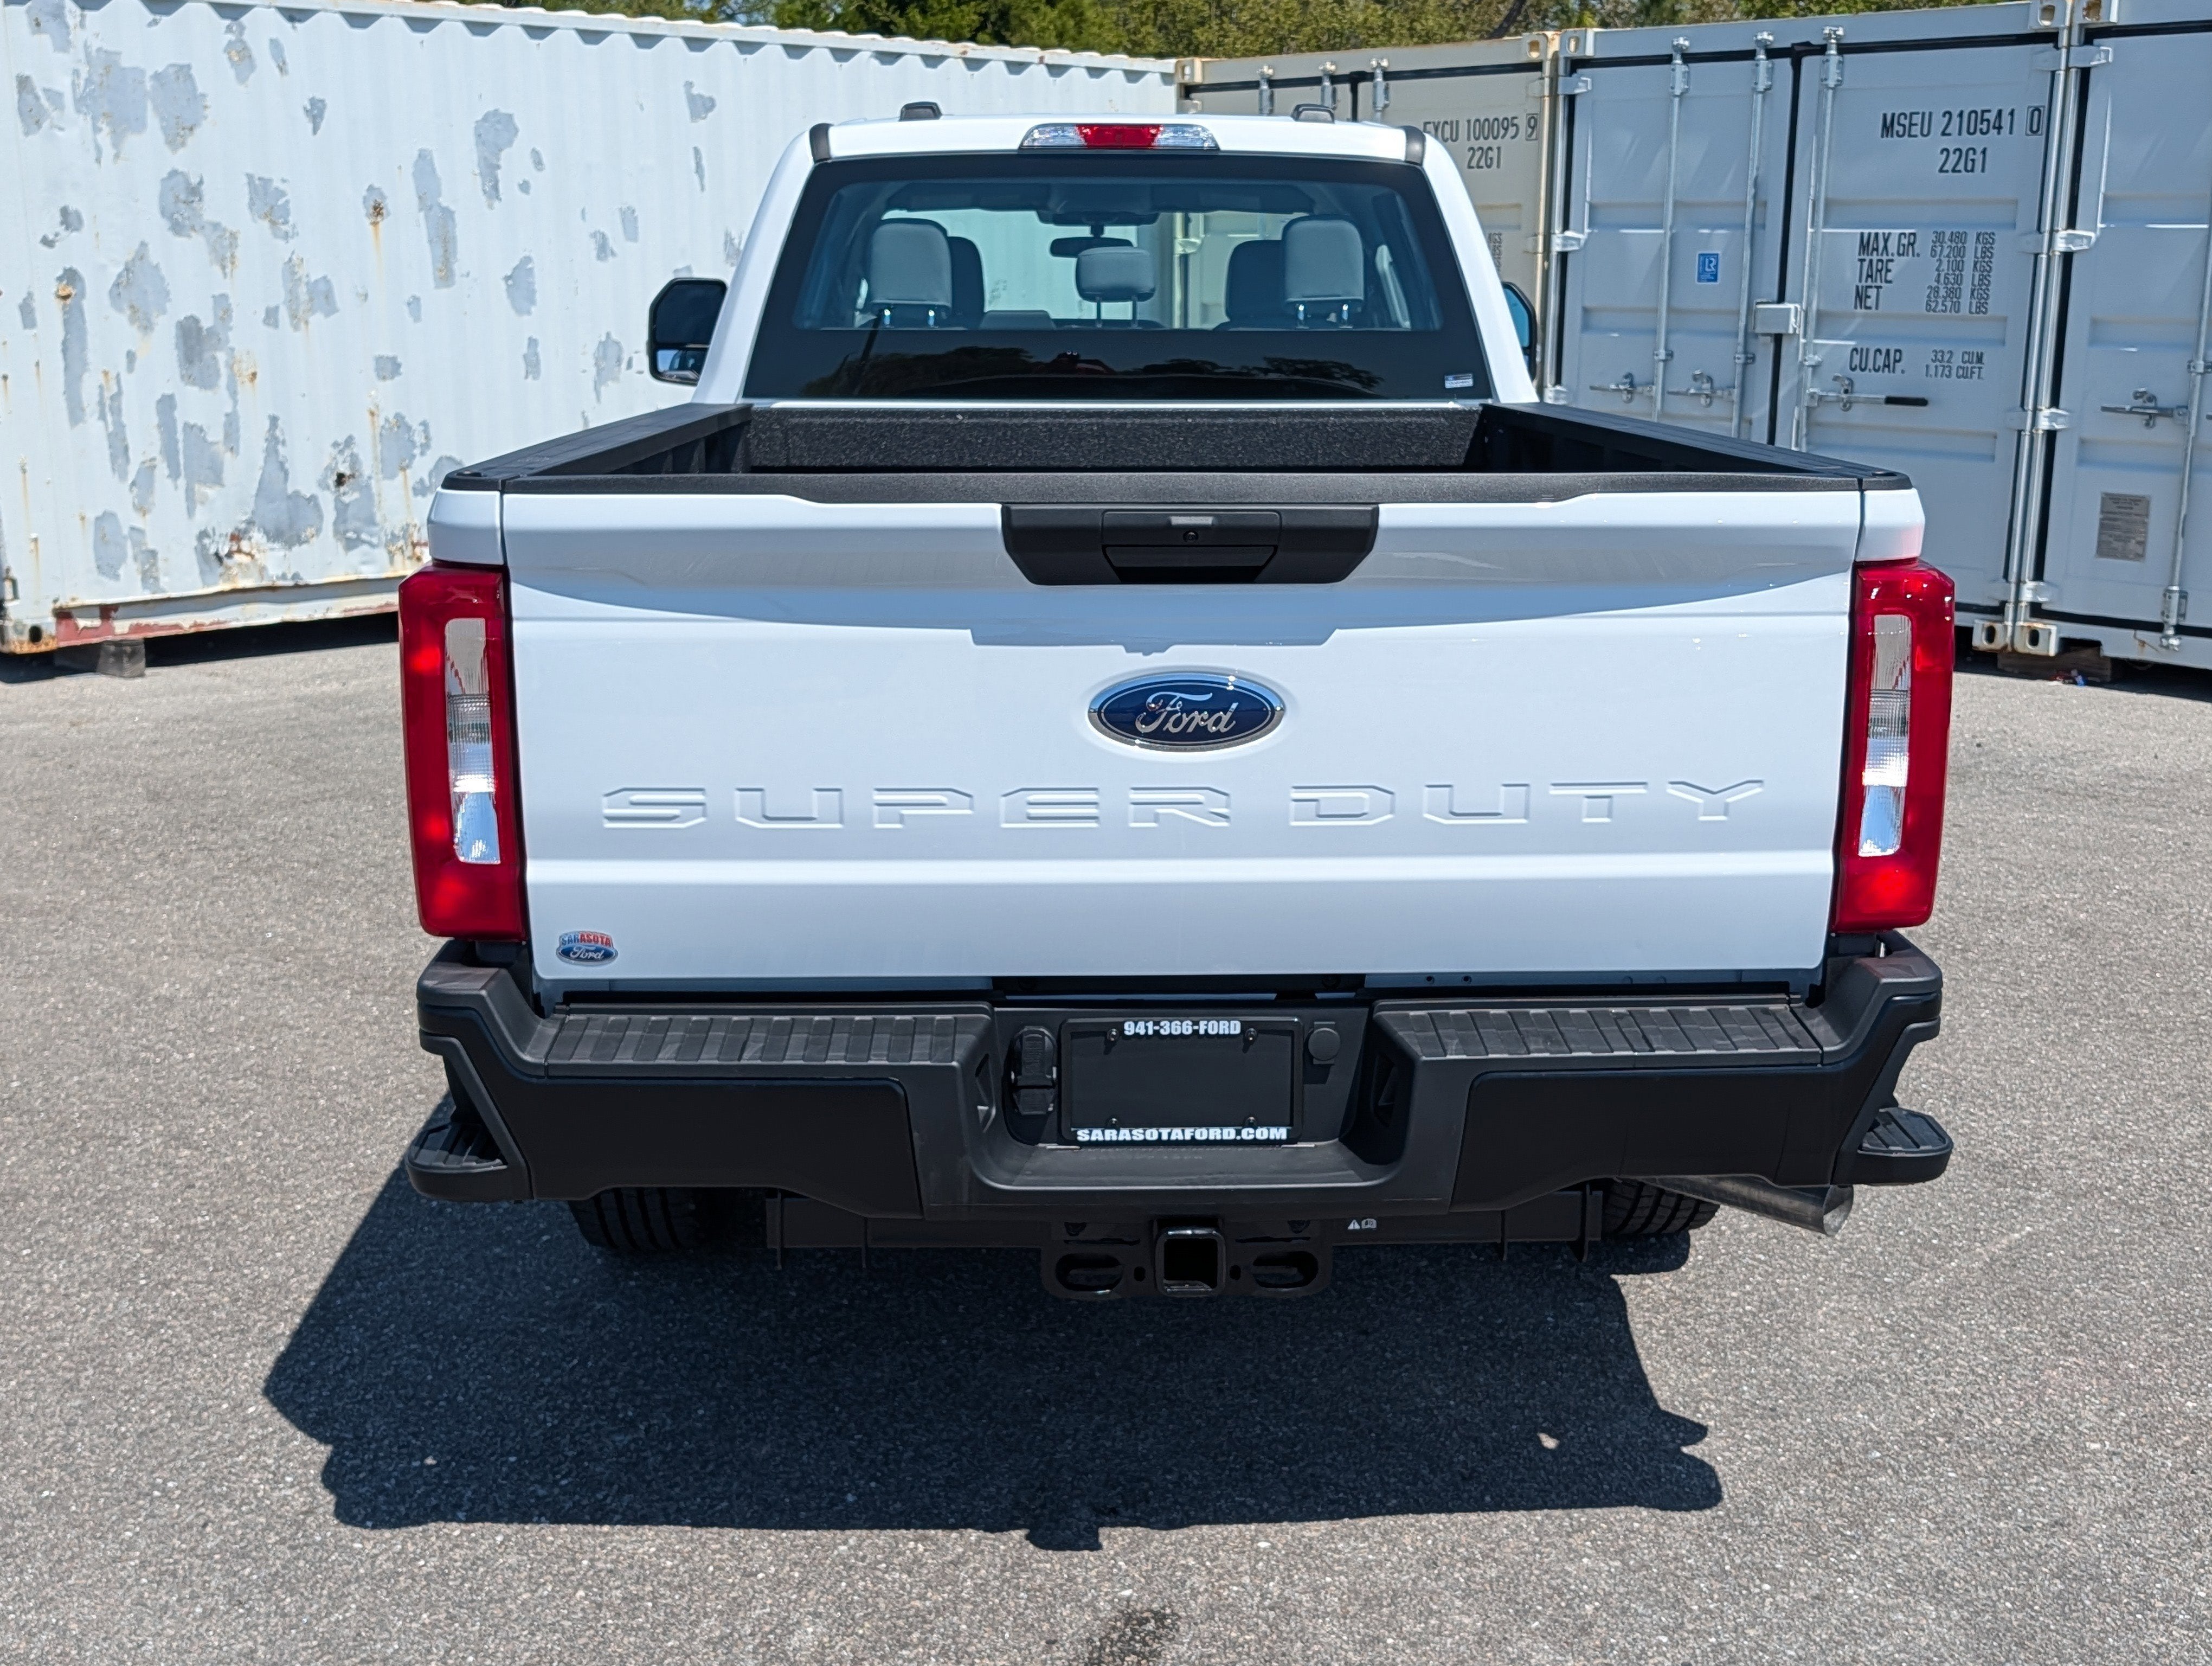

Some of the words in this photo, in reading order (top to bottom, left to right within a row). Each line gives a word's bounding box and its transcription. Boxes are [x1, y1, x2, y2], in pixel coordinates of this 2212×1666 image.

[1466, 116, 1519, 142] 100095
[1527, 115, 1538, 138] 9
[1880, 111, 1933, 138] MSEU
[1940, 108, 2015, 137] 210541
[1467, 146, 1502, 169] 22G1
[1938, 147, 1988, 174] 22G1
[1931, 230, 1968, 245] 30.480
[1975, 231, 1996, 245] KGS
[1930, 244, 1966, 259] 67.200
[1973, 246, 1994, 259] LBS
[1857, 258, 1894, 284] TARE
[1935, 258, 1965, 272] 2.100
[1972, 260, 1994, 273] KGS
[1971, 273, 1991, 287] LBS
[1853, 285, 1883, 310] NET
[1969, 286, 1990, 301] KGS
[1968, 300, 1989, 315] LBS
[1925, 363, 1953, 379] 1.173
[1135, 691, 1239, 733] Ford
[602, 786, 1231, 829] SUPER
[1288, 779, 1765, 826] DUTY
[561, 933, 612, 948] SARASOTA
[569, 946, 605, 959] Ford
[1123, 1020, 1242, 1036] 941-366-FORD
[1077, 1126, 1288, 1142] SARASOTAFORD.COM
